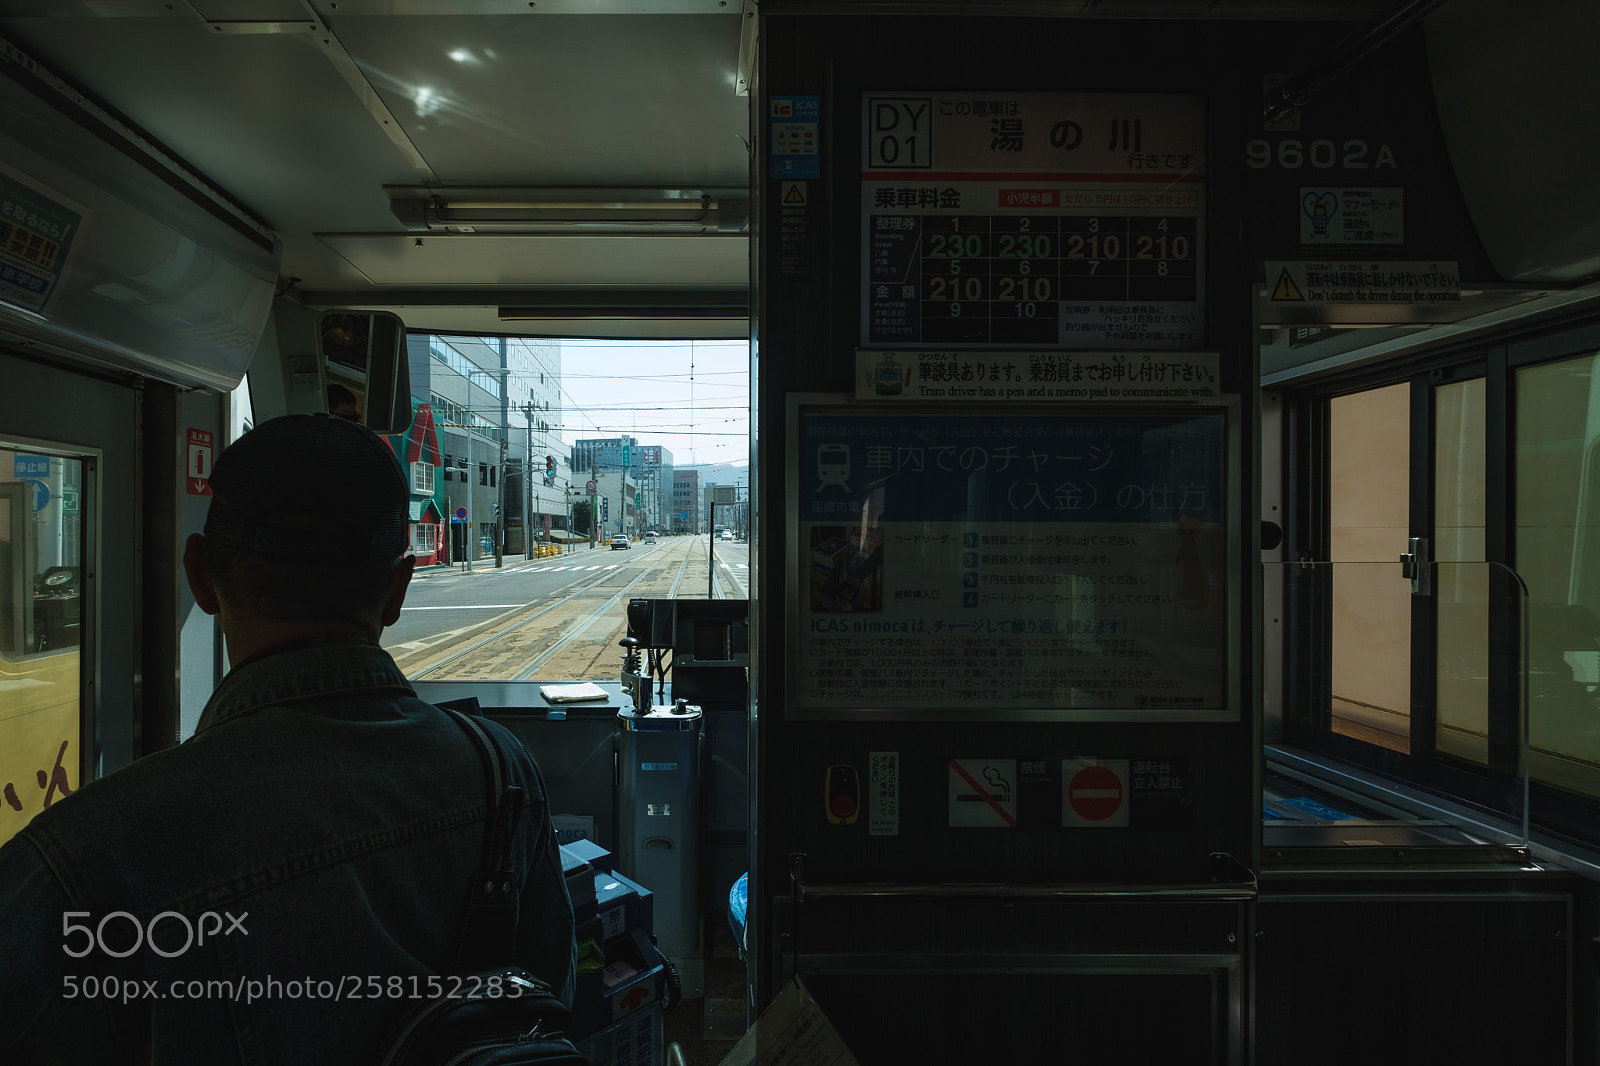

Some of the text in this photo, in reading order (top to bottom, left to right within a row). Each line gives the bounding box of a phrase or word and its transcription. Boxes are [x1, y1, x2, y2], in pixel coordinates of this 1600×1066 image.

[796, 101, 818, 110] ICAS
[939, 101, 1020, 117] この電車は
[875, 103, 927, 132] DY
[990, 118, 1142, 152] 湯の川
[880, 135, 916, 164] 01
[1245, 139, 1398, 169] 9602A
[1127, 153, 1193, 169] 行きです
[874, 187, 961, 209] 乗車料金
[1006, 192, 1053, 206] 小児半額
[1065, 193, 1092, 204] ただし
[875, 217, 916, 231] 整理券
[952, 218, 1168, 233] 1 2 3 4
[929, 235, 1190, 260] 230 230 210 210
[950, 261, 1169, 276] 5 6 7 8
[1305, 271, 1461, 288] 運転中は乗務員に話しかけないで下さい。
[929, 277, 1051, 301] 210 210
[1331, 289, 1354, 301] disturb
[1356, 289, 1367, 301] the
[1368, 289, 1389, 301] driver
[1390, 289, 1412, 304] during
[1414, 289, 1425, 301] the
[949, 304, 1036, 319] 9 10
[918, 353, 948, 361] ひつだん
[1112, 354, 1125, 362] もう
[918, 362, 1216, 383] 筆談具あります。乗務員までお申し付け下さい。
[918, 386, 1217, 399] Tram driver has a pen and a memo pad to communicate with.
[191, 431, 211, 444] 消火器
[864, 444, 1114, 473] 車内でのチャージ
[16, 462, 48, 473] 停止線
[1006, 481, 1209, 513] （入金）の仕方
[894, 534, 958, 545] カードリーダー
[810, 619, 848, 632] ICAS
[853, 619, 908, 632] nimoca
[871, 756, 879, 783] ください
[1020, 761, 1047, 775] 禁煙
[1132, 761, 1171, 775] 運転台
[880, 756, 888, 816] ボタンを押して
[1132, 775, 1184, 790] 立入禁止
